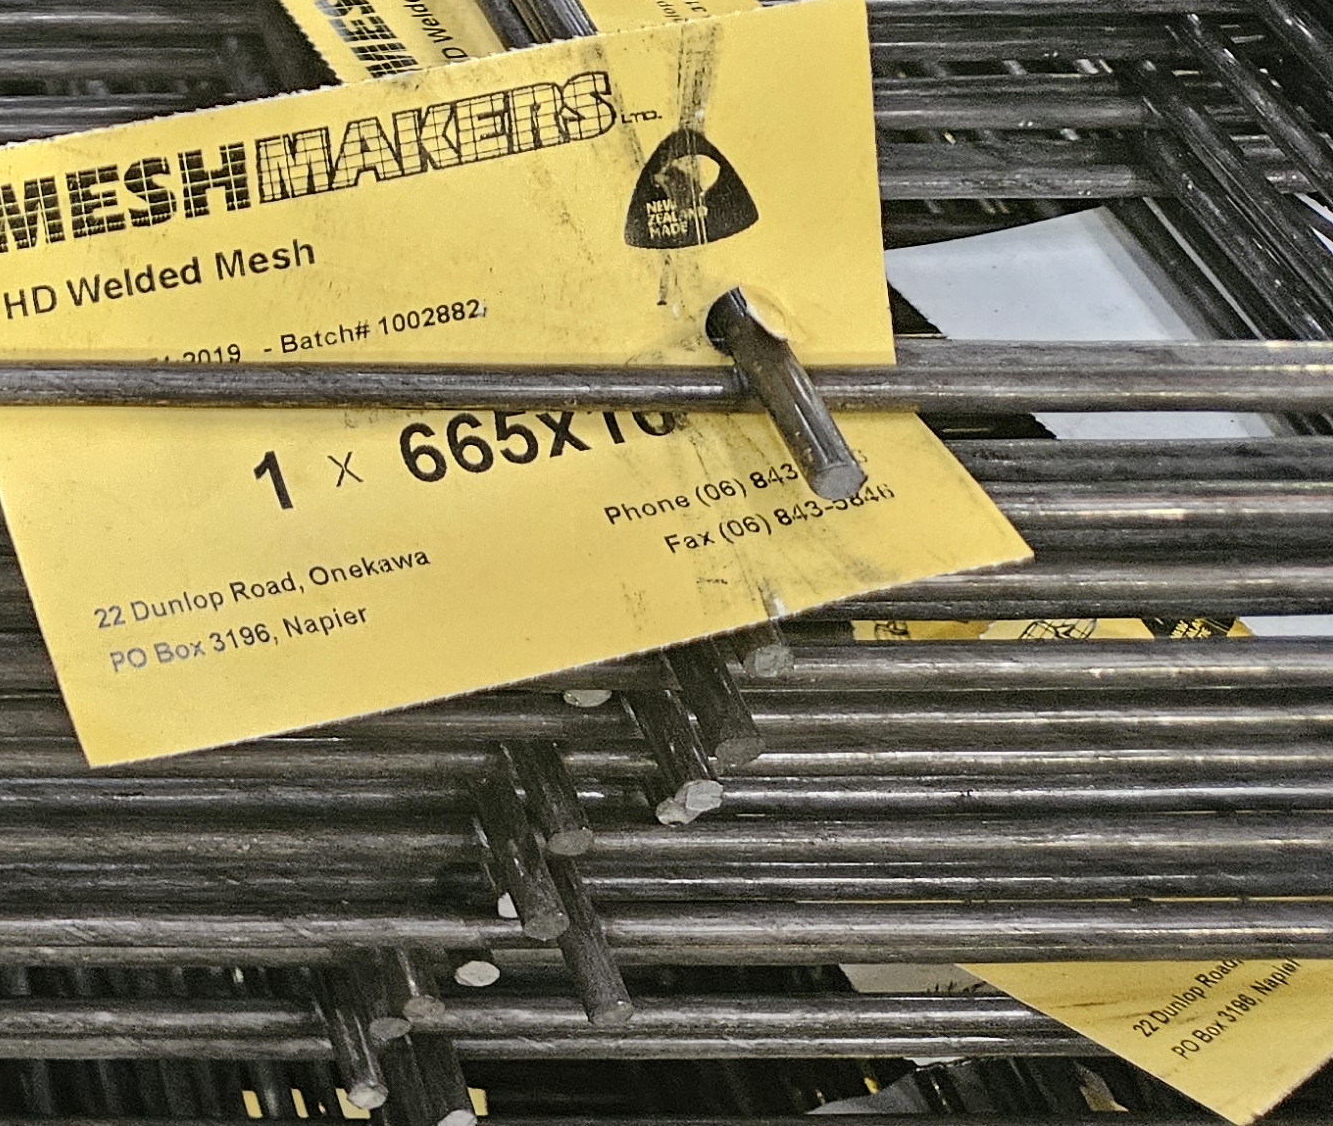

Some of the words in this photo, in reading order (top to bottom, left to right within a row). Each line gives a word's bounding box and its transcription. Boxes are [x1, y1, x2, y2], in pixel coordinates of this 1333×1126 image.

[646, 198, 678, 215] NEW
[648, 205, 709, 228] ZEALAND
[649, 220, 689, 240] MADE
[3, 284, 58, 320] HD
[66, 255, 203, 307] Welded
[215, 238, 316, 281] Mesh
[279, 318, 371, 354] Batch#
[253, 450, 294, 511] 1
[604, 493, 691, 525] Phone
[694, 478, 747, 507] (06)
[663, 530, 716, 554] Fax
[719, 513, 772, 544] (06)
[94, 605, 126, 629] 22
[130, 591, 225, 622] Dunlop
[229, 571, 305, 604] Road,
[308, 550, 431, 586] Onekawa
[109, 647, 148, 673] PO
[153, 640, 206, 664] Box
[209, 623, 279, 653] 3196,
[282, 605, 368, 638] Napier
[1133, 1019, 1160, 1039] 22
[1149, 985, 1208, 1025] Dunlop
[1171, 1038, 1201, 1060] PO
[1191, 1019, 1229, 1044] Box
